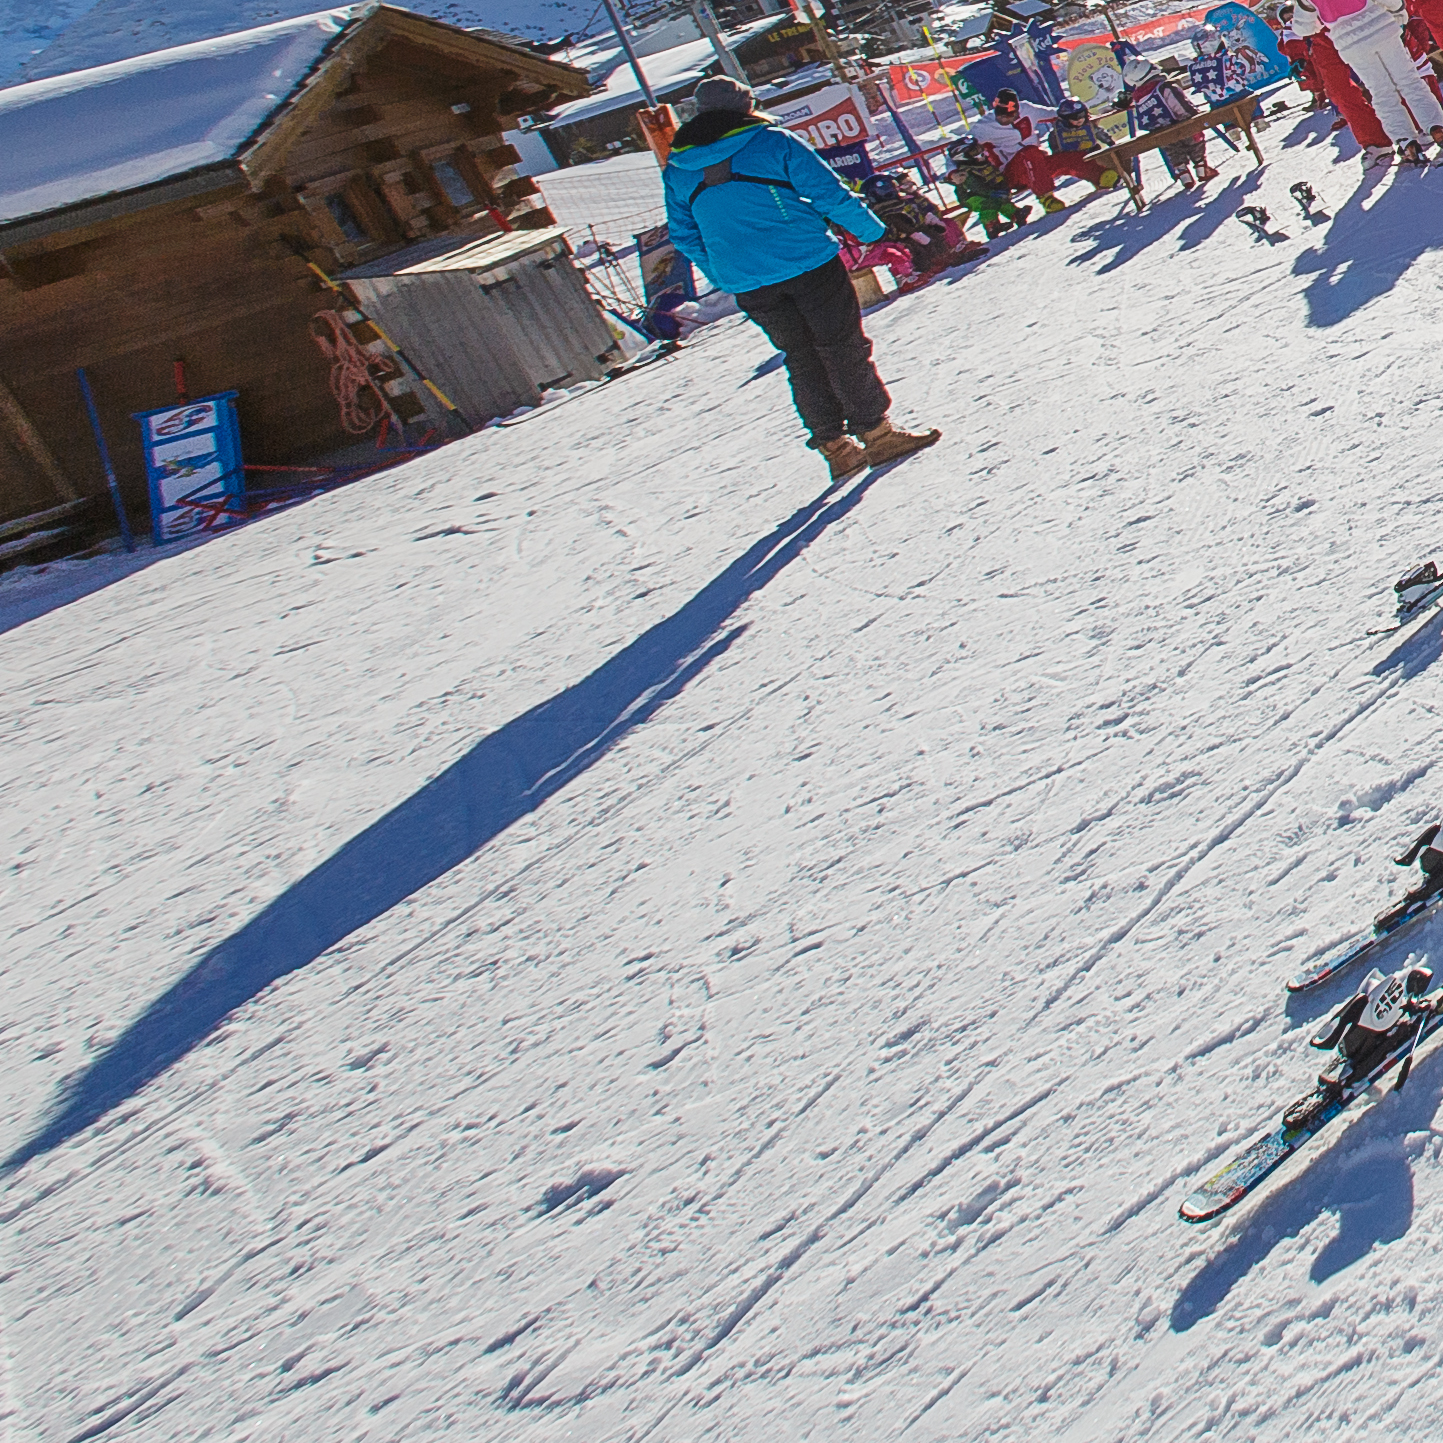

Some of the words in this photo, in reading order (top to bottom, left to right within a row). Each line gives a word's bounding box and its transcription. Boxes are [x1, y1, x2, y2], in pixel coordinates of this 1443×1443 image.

[1077, 51, 1098, 64] Club
[1073, 62, 1093, 83] Piou
[1096, 55, 1114, 66] Pio
[830, 153, 861, 169] ARIBO
